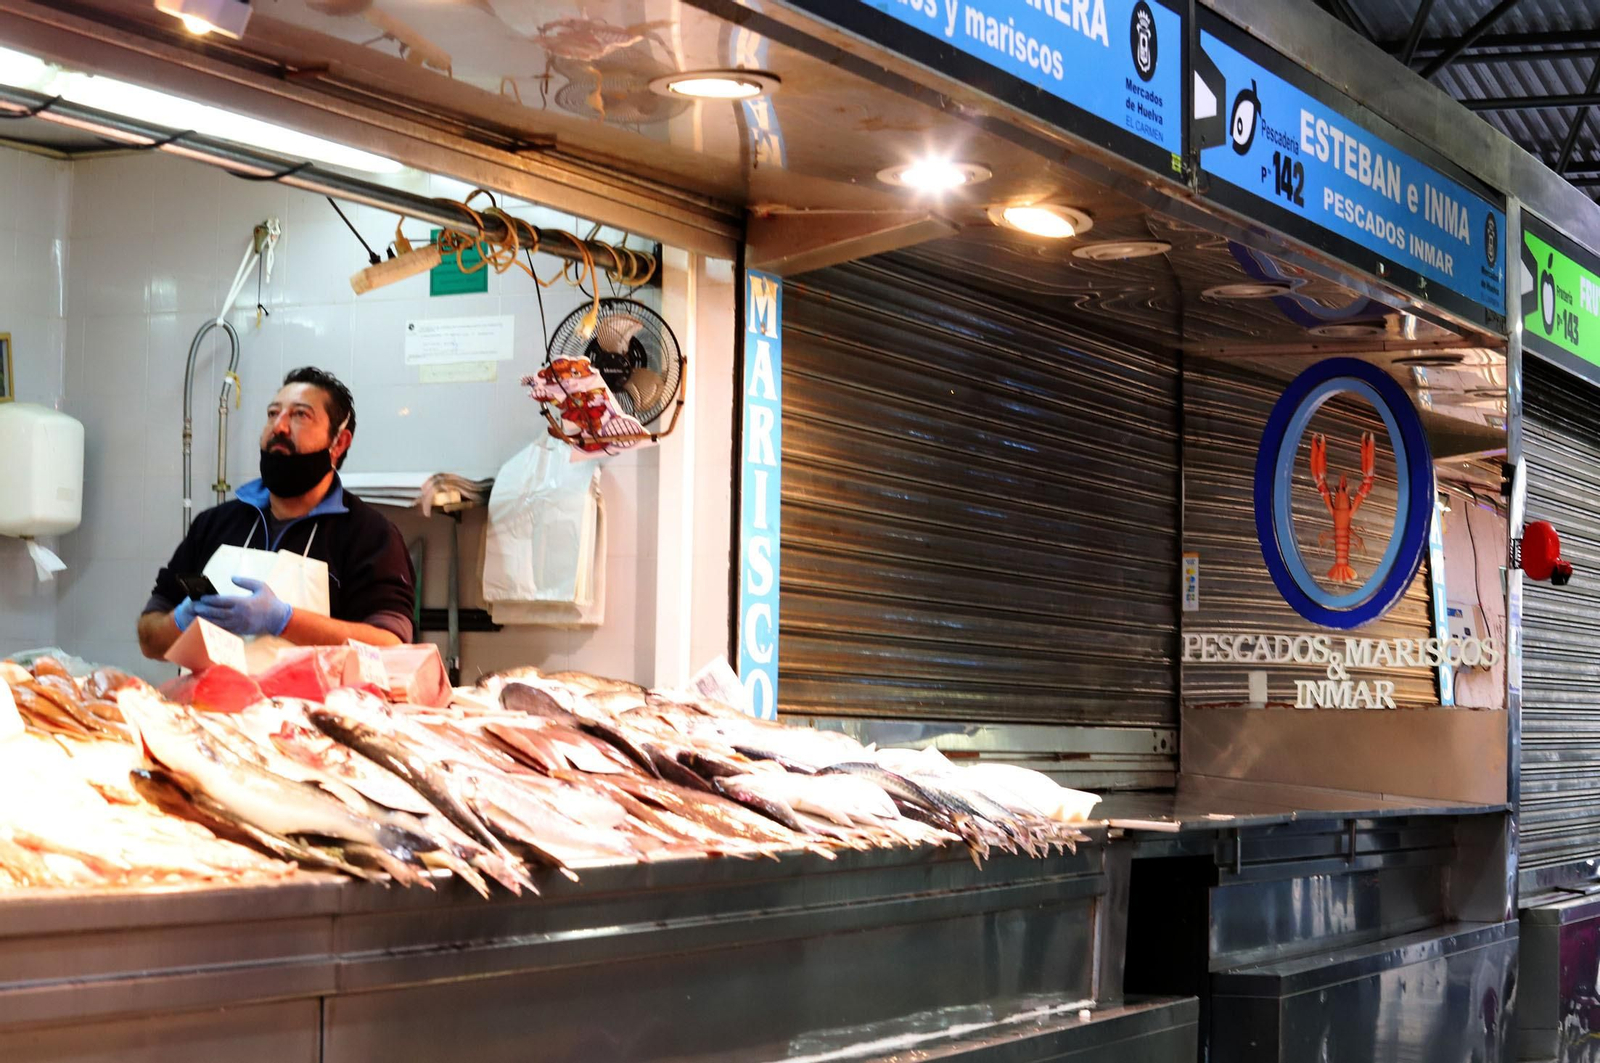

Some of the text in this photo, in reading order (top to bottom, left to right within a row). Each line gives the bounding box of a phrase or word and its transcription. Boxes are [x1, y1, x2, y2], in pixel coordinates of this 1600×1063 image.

[965, 4, 1064, 80] mariscos
[1126, 77, 1163, 107] Mercados
[1126, 97, 1163, 126] de Huelva
[1135, 119, 1164, 142] CARMEN
[1273, 150, 1305, 209] 142
[1300, 108, 1470, 246] ESTEBAN e INMA
[1323, 186, 1454, 278] PESCADOS INMAR
[1563, 309, 1579, 346] 143
[744, 274, 778, 721] MARISCO
[1182, 632, 1501, 667] PESCADOS MARISCOS
[1326, 651, 1350, 681] &
[1293, 680, 1397, 709] INMAR
